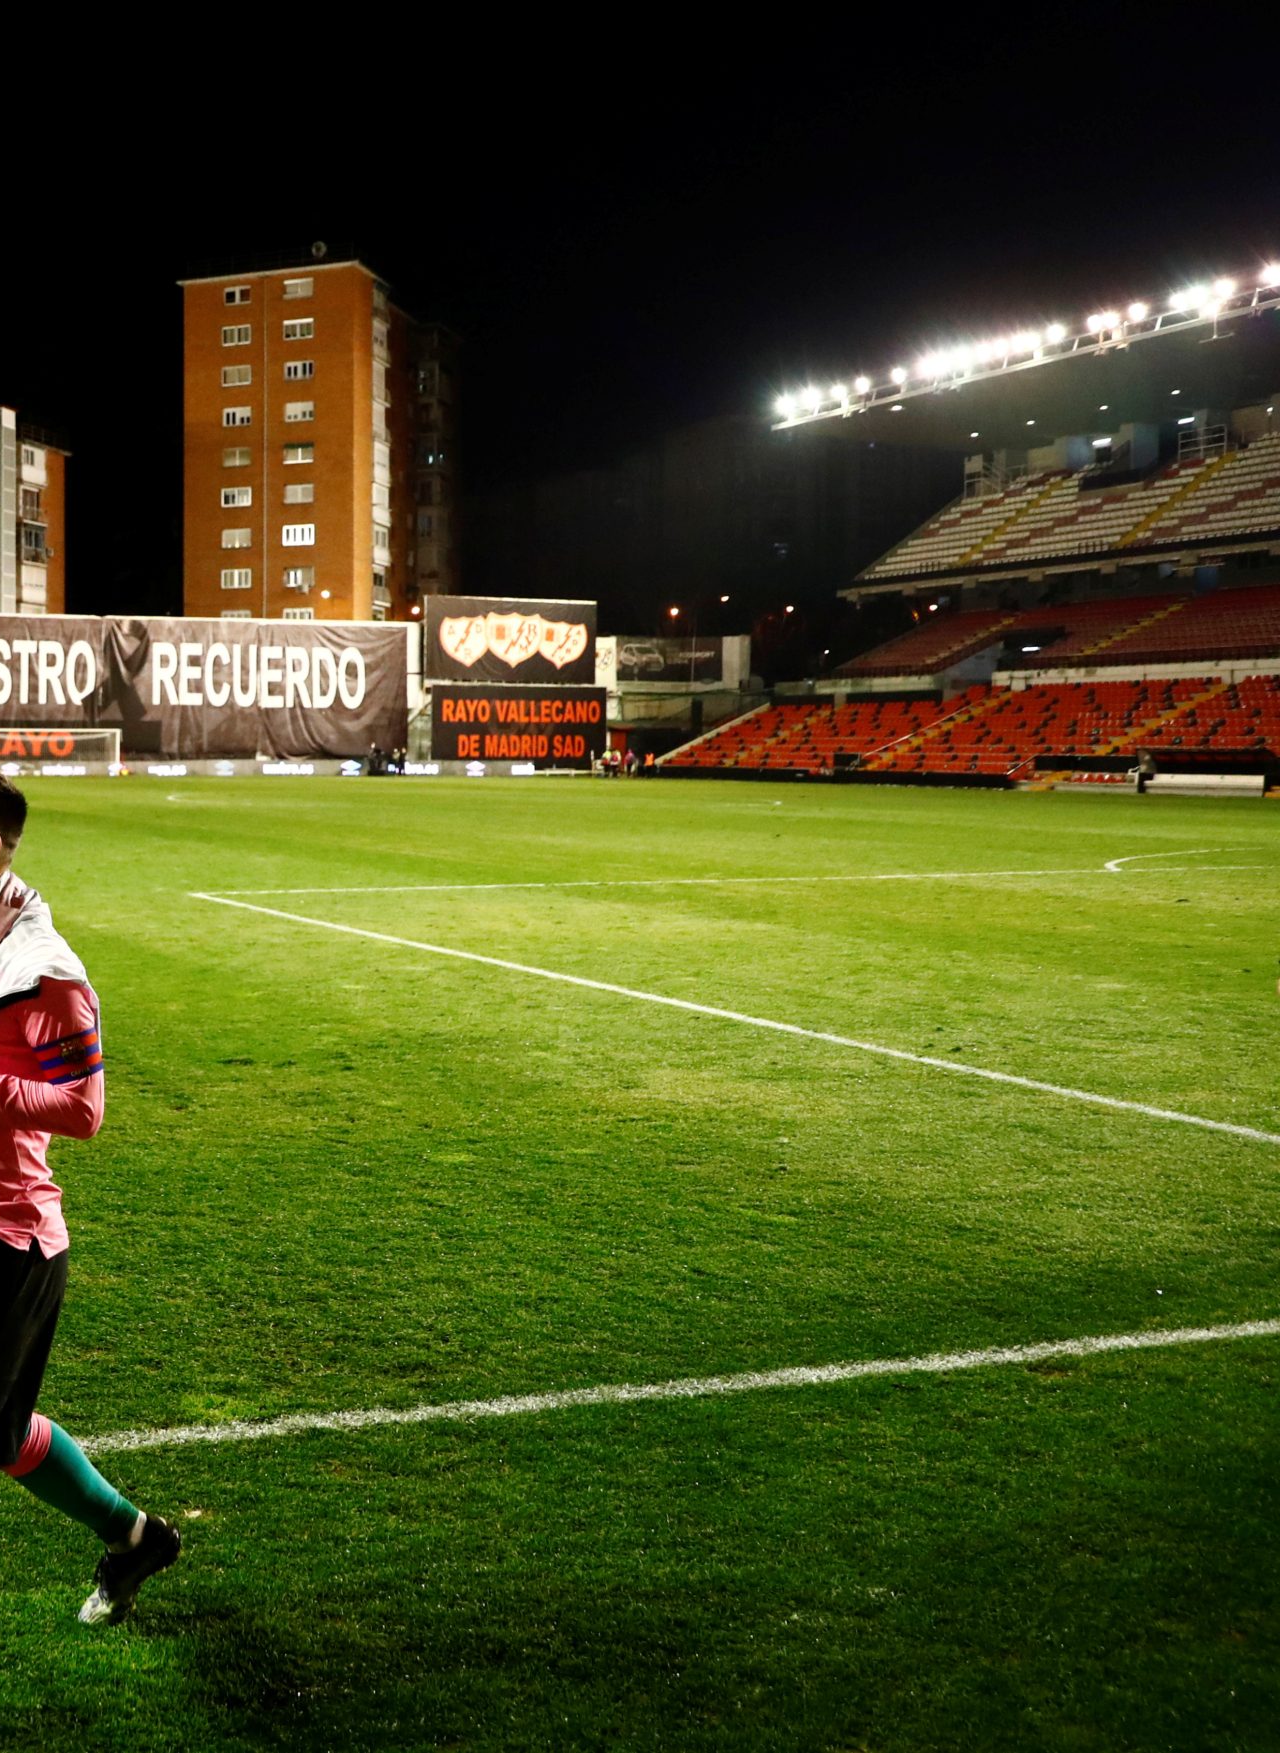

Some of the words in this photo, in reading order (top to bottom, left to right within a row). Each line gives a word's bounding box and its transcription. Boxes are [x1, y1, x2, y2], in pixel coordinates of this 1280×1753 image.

[151, 641, 367, 710] RECUERDO
[442, 698, 491, 723] RAYO
[495, 699, 602, 724] VALLECANO
[457, 734, 480, 758] DE
[485, 734, 549, 758] MADRID
[553, 735, 586, 758] SAD
